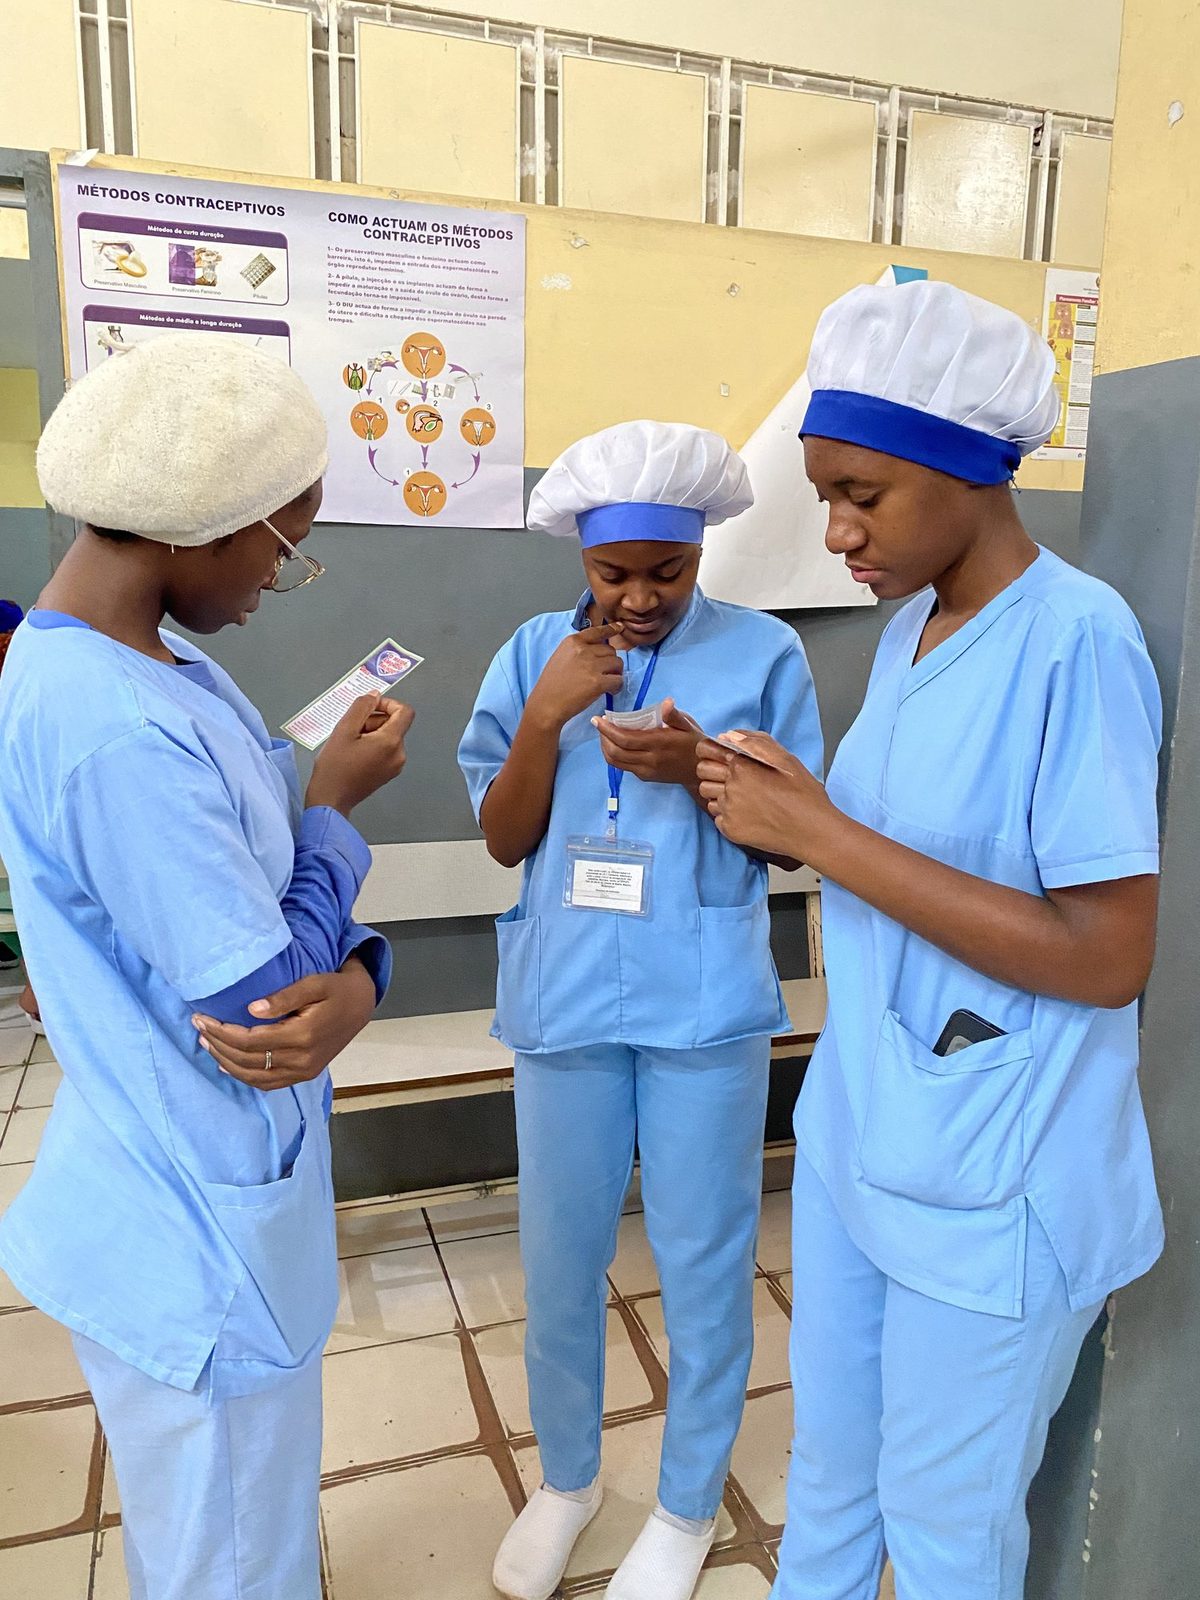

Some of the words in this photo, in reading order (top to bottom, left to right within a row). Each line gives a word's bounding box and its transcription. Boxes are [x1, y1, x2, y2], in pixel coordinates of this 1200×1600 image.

[77, 184, 150, 202] MÉTODOS
[155, 193, 285, 217] CONTRACEPTIVOS
[147, 225, 173, 233] Métodos
[200, 231, 224, 239] duração
[329, 212, 368, 226] COMO
[372, 217, 427, 232] ACTUAM
[431, 223, 449, 233] OS
[452, 224, 514, 241] MÉTODOS
[363, 229, 481, 250] CONTRACEPTIVOS
[139, 314, 165, 323] Métodos
[175, 317, 194, 325] média
[200, 318, 218, 327] longa
[218, 320, 242, 329] duração
